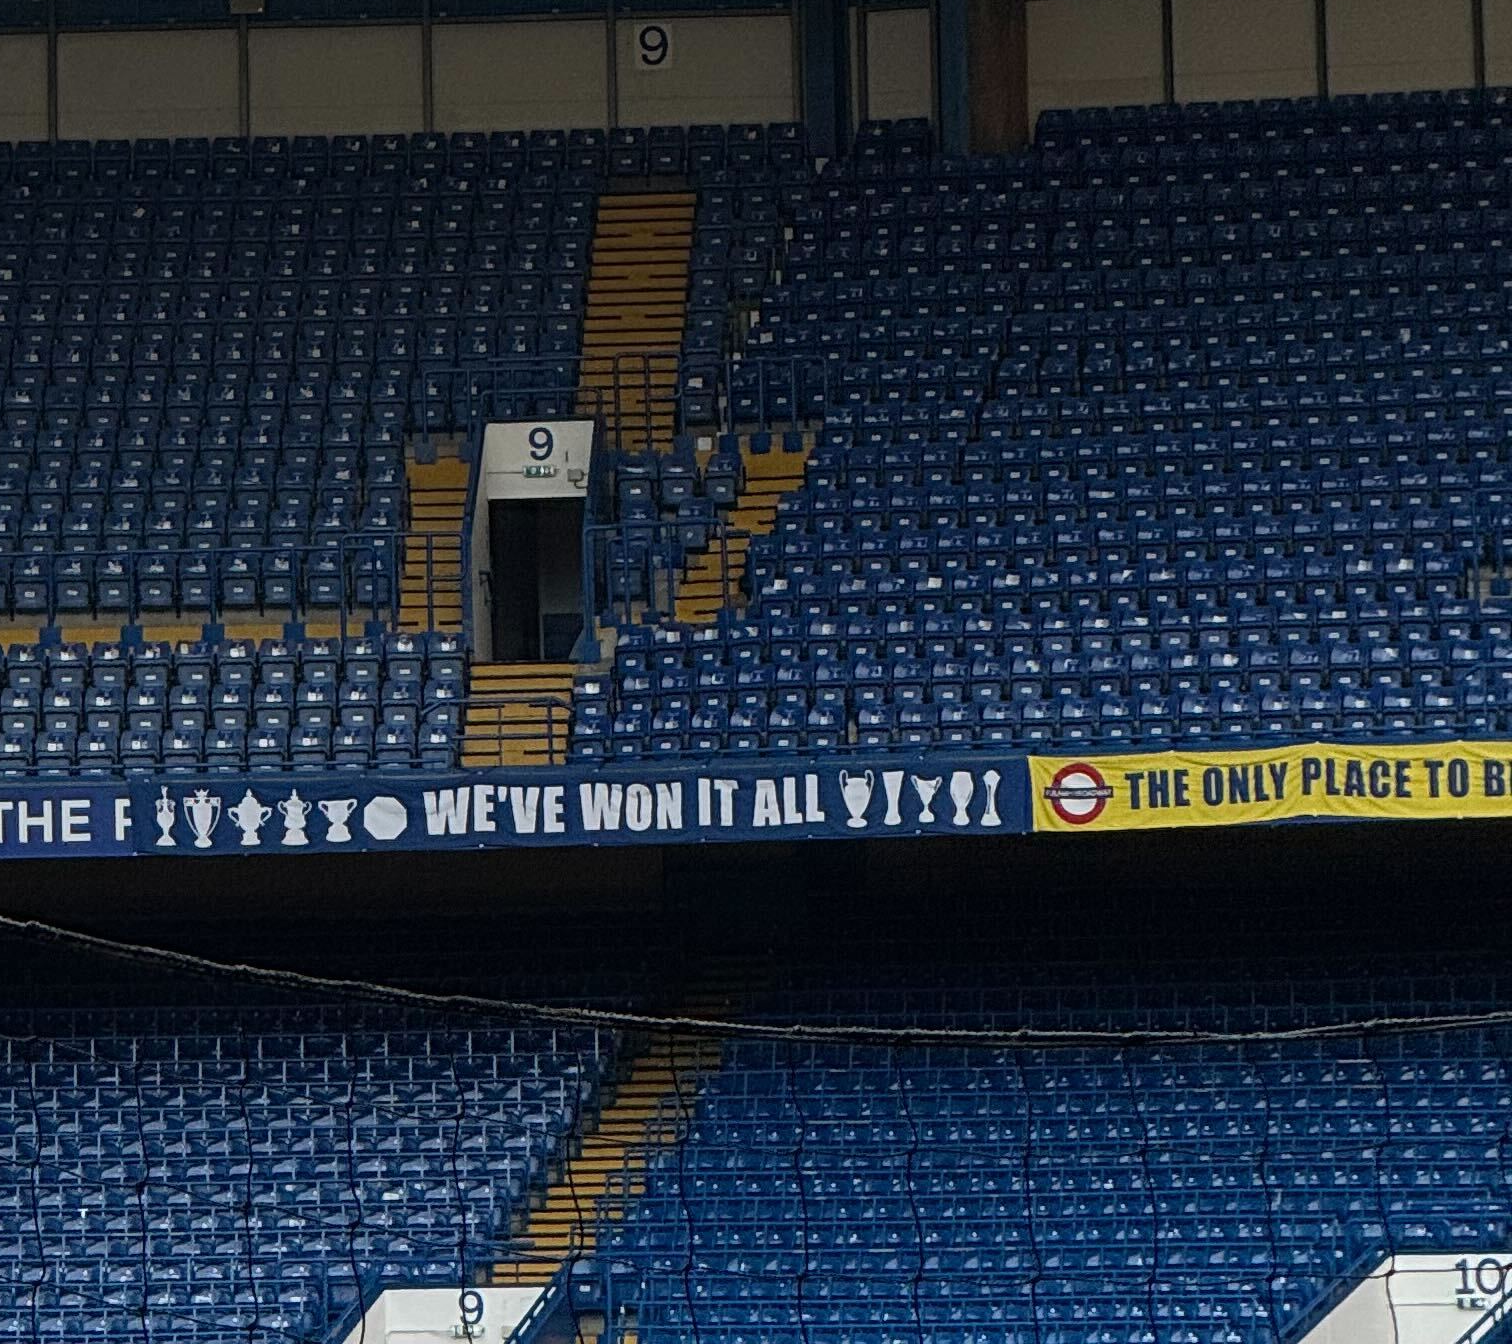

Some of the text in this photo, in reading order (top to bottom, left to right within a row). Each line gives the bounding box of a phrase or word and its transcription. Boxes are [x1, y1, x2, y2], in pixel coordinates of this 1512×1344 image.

[639, 25, 668, 65] 9
[528, 427, 553, 461] 9
[1125, 758, 1512, 810] THE ONLY PLACE TO B
[423, 774, 825, 835] WE'VE WON IT ALL
[1455, 1258, 1503, 1295] 10
[459, 1290, 484, 1325] 9
